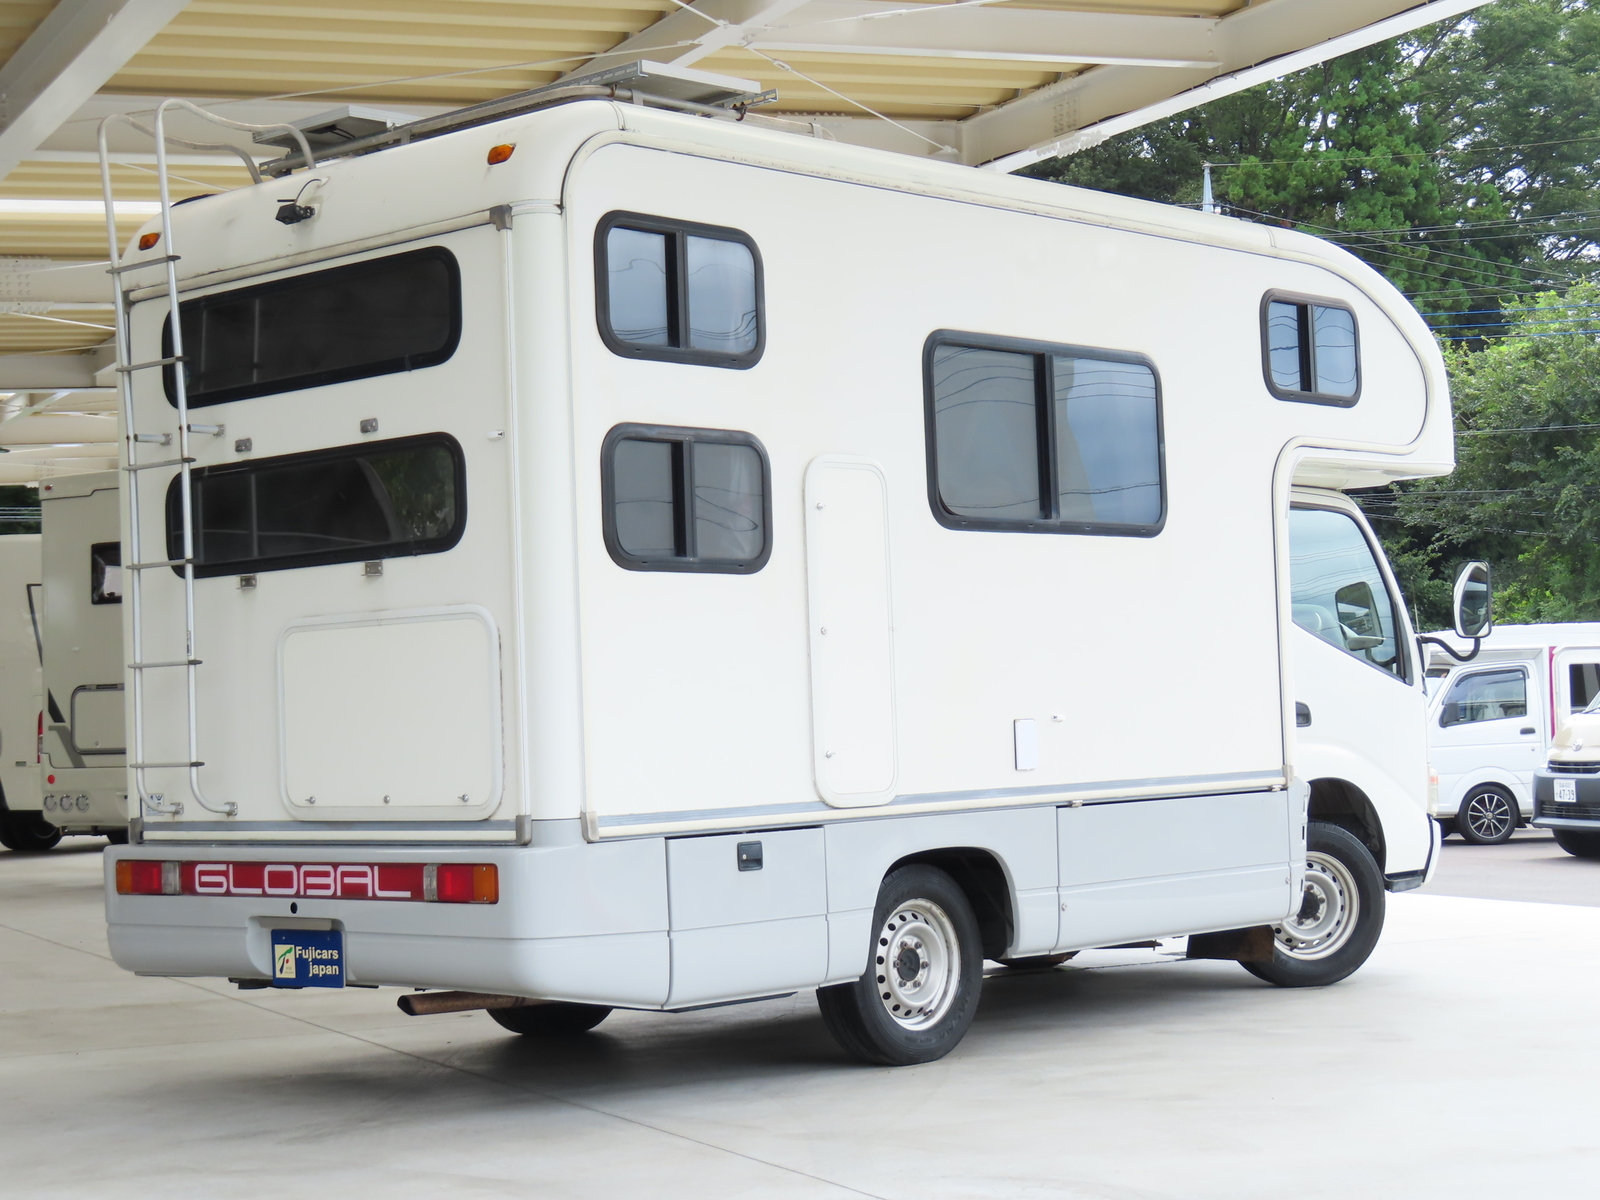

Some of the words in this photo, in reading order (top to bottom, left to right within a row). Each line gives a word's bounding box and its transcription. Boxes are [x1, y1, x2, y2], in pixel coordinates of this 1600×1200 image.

[194, 863, 411, 898] GLOBAL
[295, 946, 339, 962] Fujicars
[308, 962, 339, 977] japan
